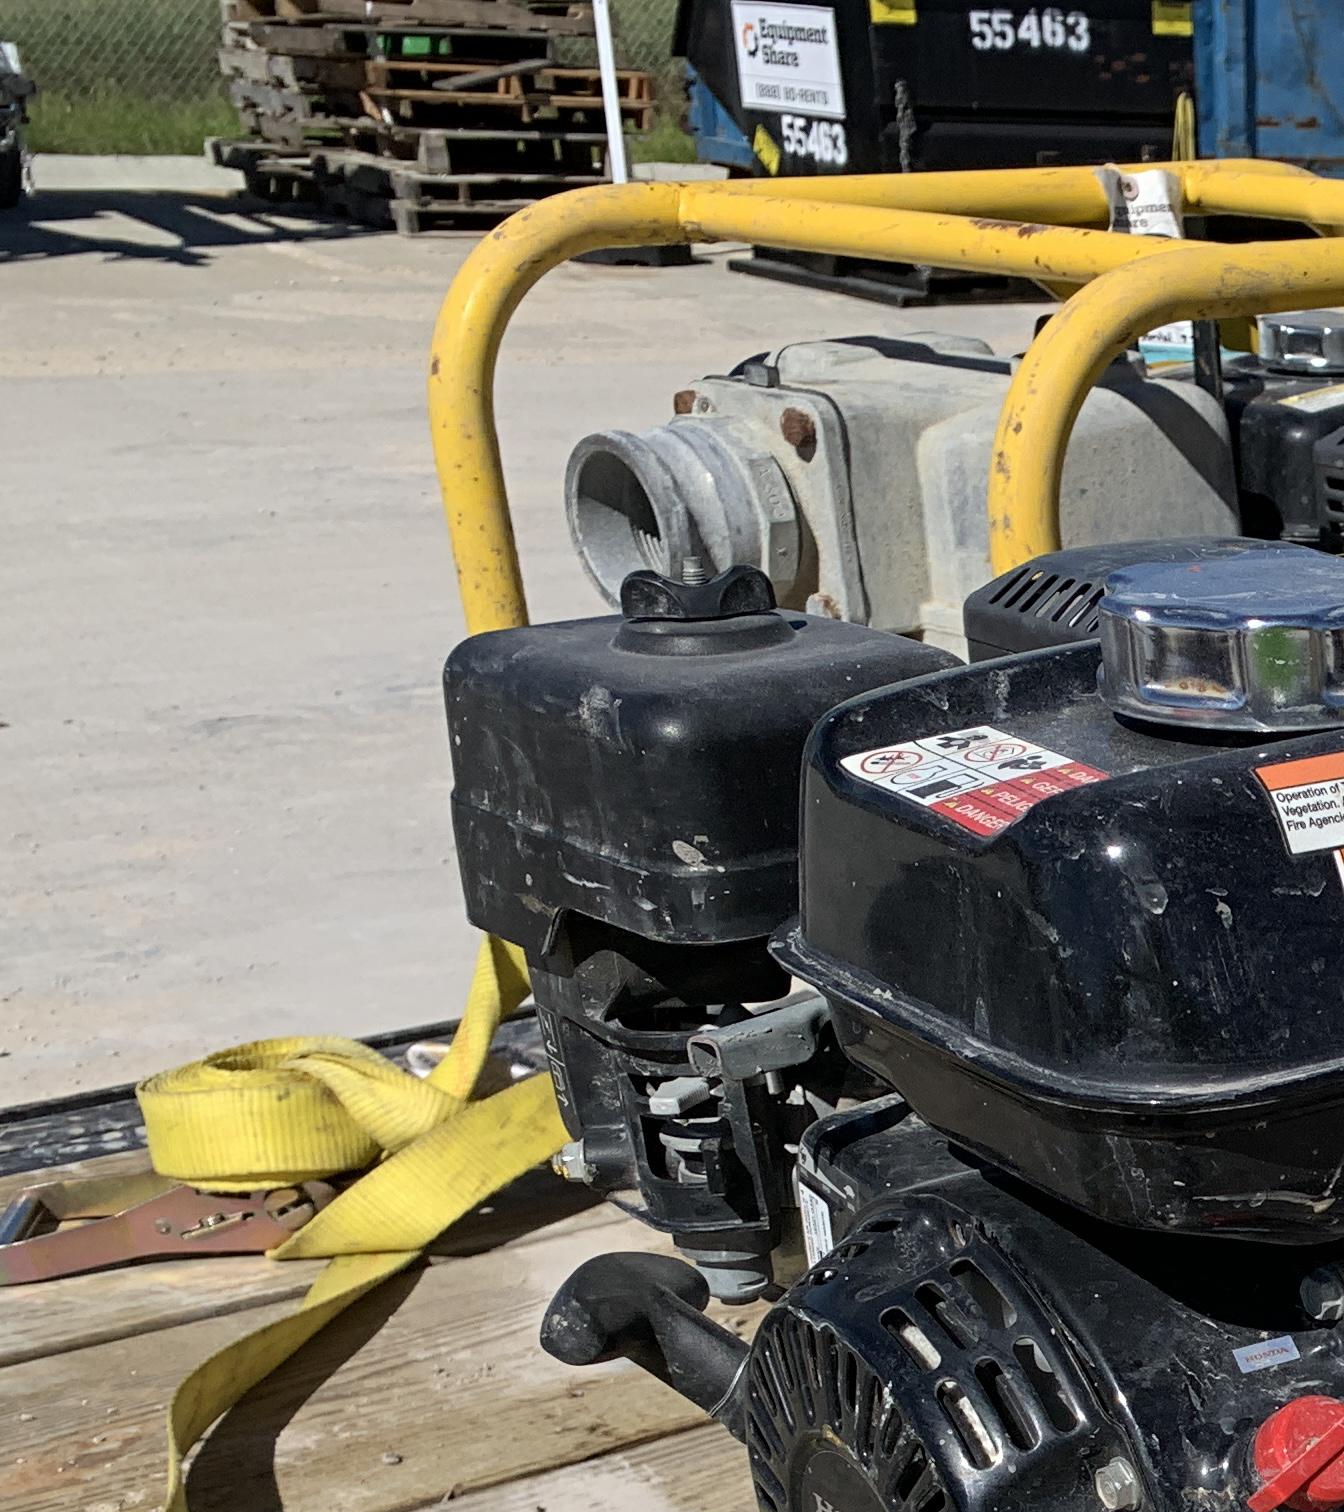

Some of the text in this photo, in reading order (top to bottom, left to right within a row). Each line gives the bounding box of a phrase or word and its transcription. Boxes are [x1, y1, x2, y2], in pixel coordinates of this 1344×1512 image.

[758, 18, 829, 46] Equipment
[970, 8, 1090, 52] 55463
[761, 43, 800, 67] Share
[781, 114, 848, 165] 55463
[1275, 787, 1328, 804] Operation
[1329, 782, 1340, 793] of
[1281, 799, 1340, 817] Vegetation.
[1285, 819, 1306, 831] Fire
